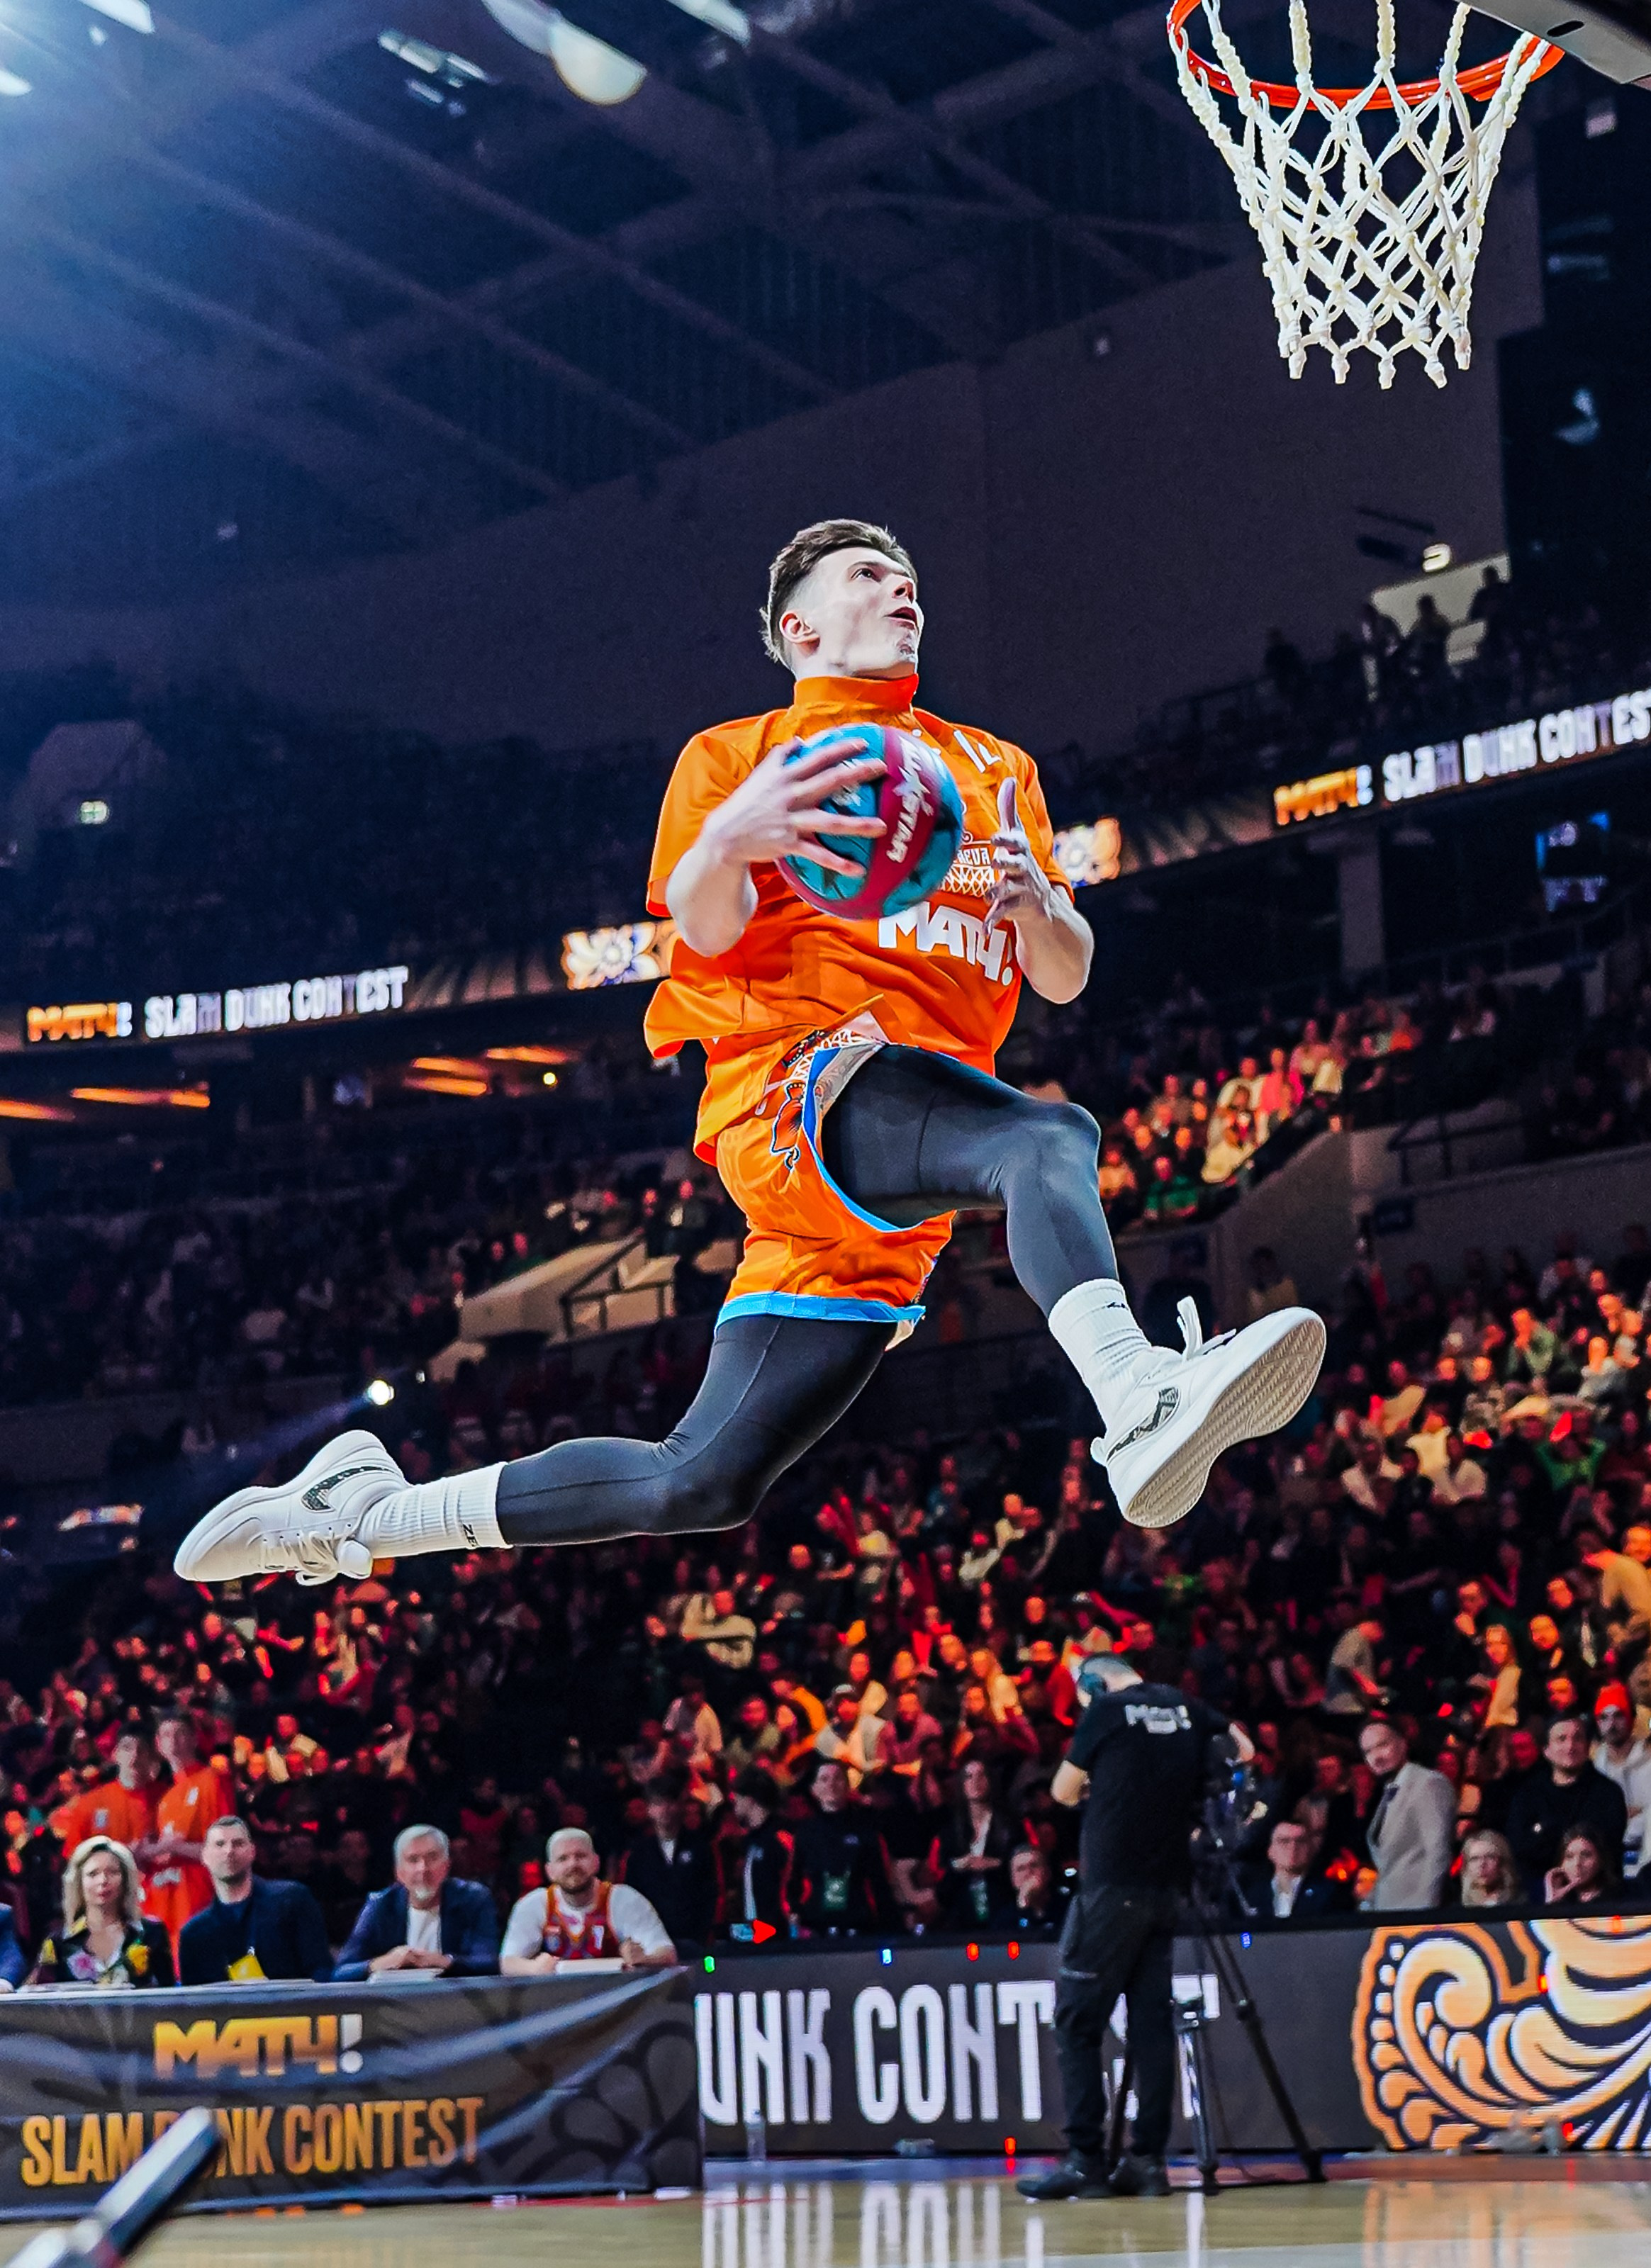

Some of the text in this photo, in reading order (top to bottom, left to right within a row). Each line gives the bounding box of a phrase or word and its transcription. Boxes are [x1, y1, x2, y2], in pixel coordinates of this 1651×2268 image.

[1382, 741, 1461, 802] SLAM
[1463, 719, 1538, 783] DUNK
[1539, 687, 1651, 763] CONTES
[144, 992, 222, 1038] SLAM
[225, 982, 291, 1032] DUNK
[293, 965, 408, 1021] CONTEST
[694, 1973, 1220, 2125] UNK CONTT
[21, 2111, 144, 2187] SLAM
[283, 2096, 486, 2175] CONTEST
